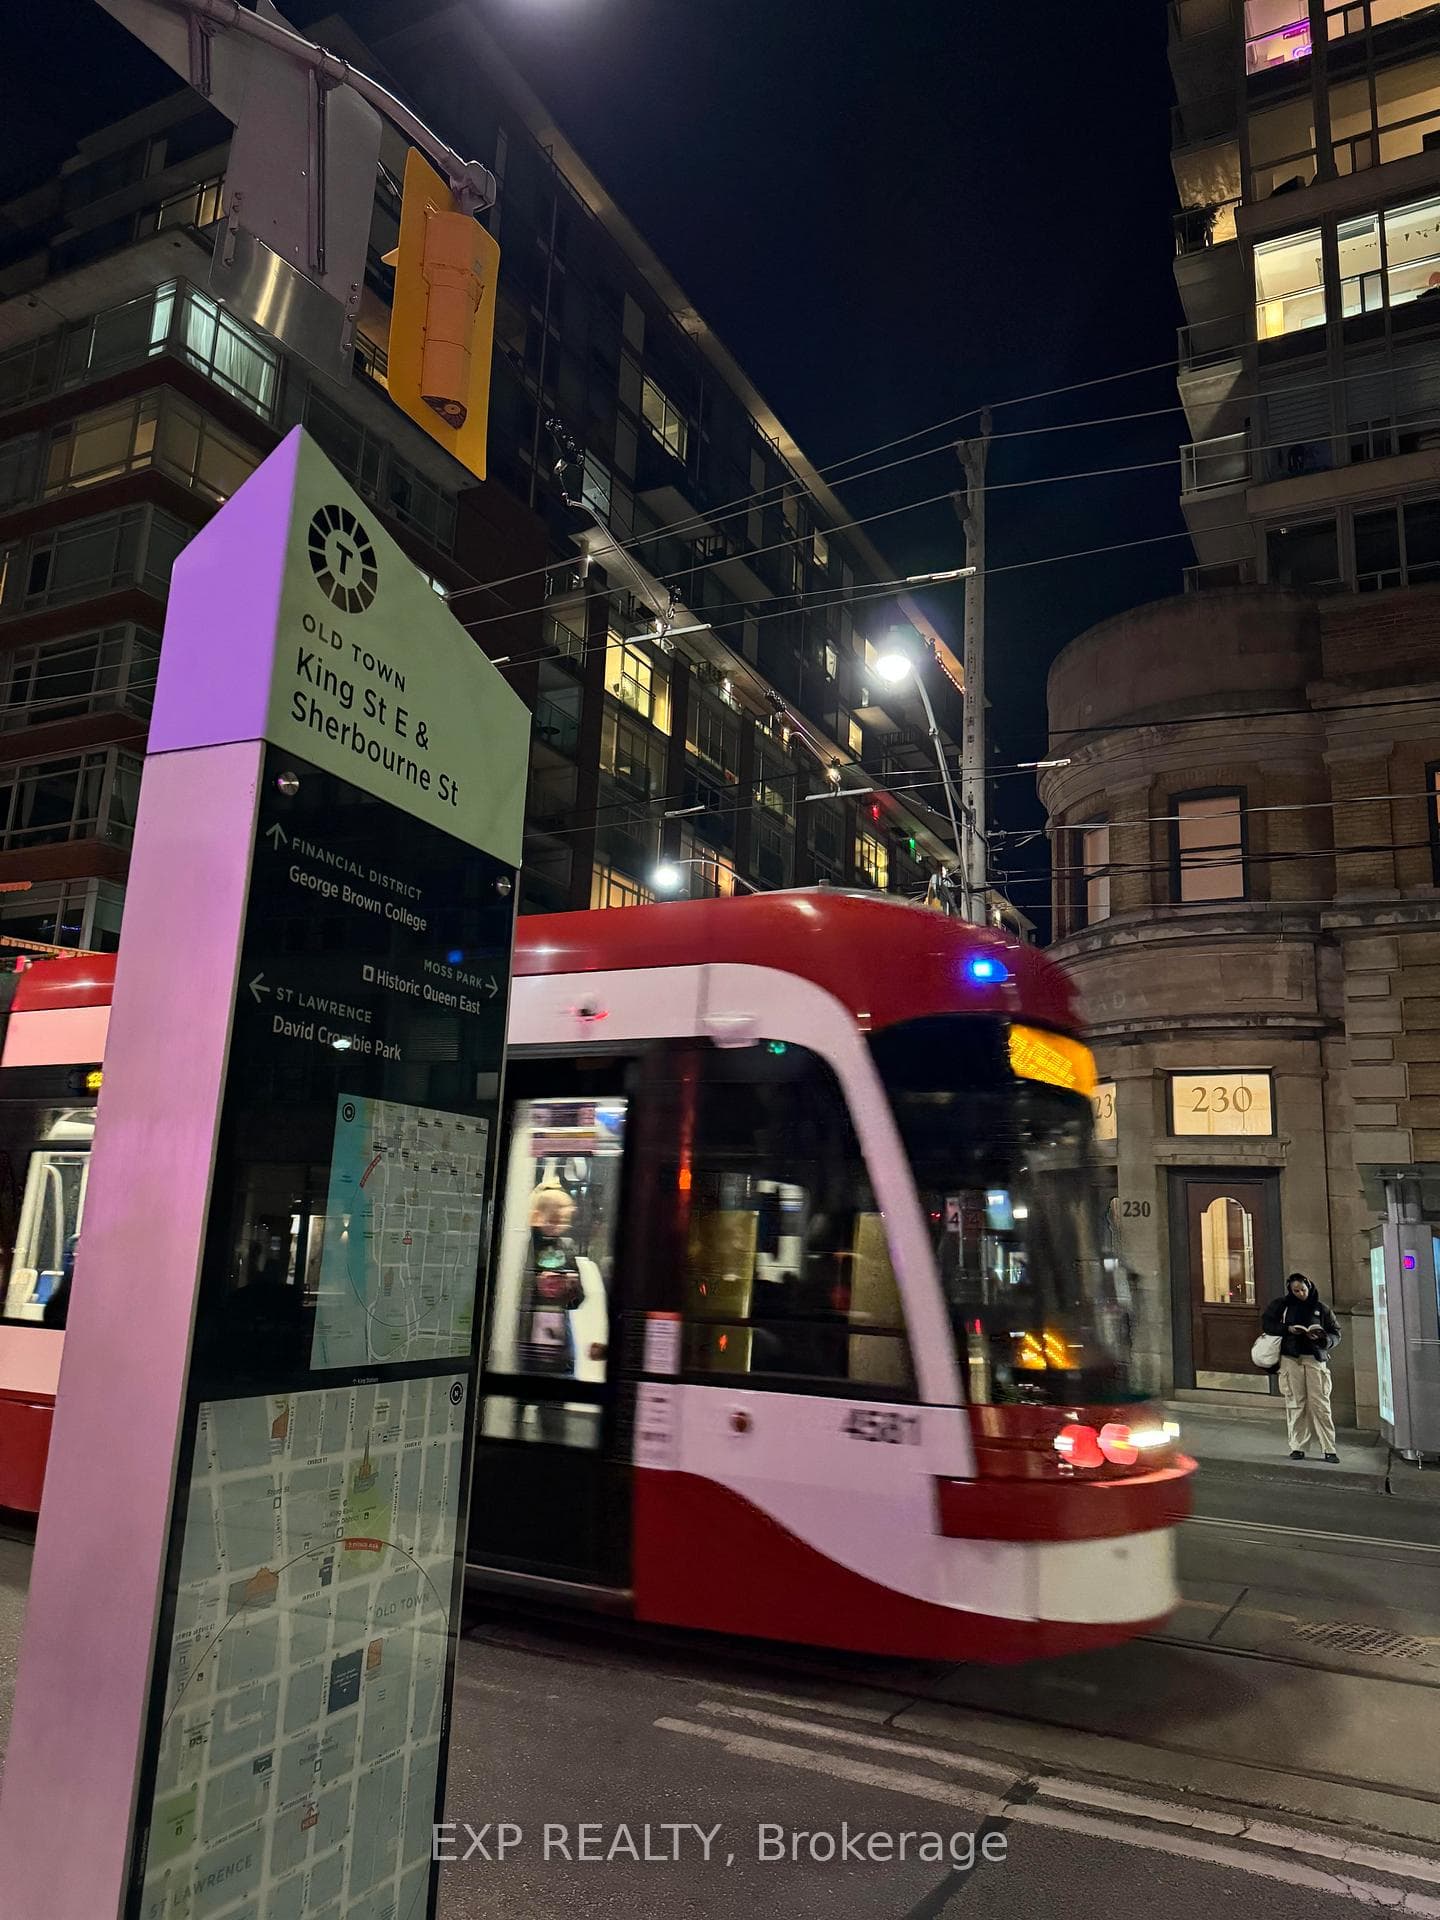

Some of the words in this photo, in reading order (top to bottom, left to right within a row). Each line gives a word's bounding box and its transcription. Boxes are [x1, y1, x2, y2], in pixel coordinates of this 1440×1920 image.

[302, 613, 343, 650] OLD
[351, 643, 406, 693] TOWN
[296, 647, 354, 710] King
[363, 688, 387, 726] St
[395, 706, 408, 738] E
[415, 720, 429, 751] &
[291, 691, 431, 790] Sherbourne
[438, 773, 459, 807] St
[292, 837, 365, 879] FINANCIAL
[369, 869, 423, 901] DISTRICT
[289, 865, 339, 899] George
[342, 885, 382, 915] Brown
[385, 902, 427, 932] College
[376, 968, 420, 998] Historic
[423, 983, 457, 1010] Queen
[459, 994, 481, 1015] East
[424, 959, 453, 980] MOSS
[456, 970, 482, 990] PARK
[276, 987, 294, 1002] ST
[298, 993, 372, 1024] LAWRENCE
[273, 1014, 314, 1042] David
[375, 1038, 401, 1061] Park
[1191, 1086, 1253, 1113] 230
[1122, 1200, 1151, 1218] 230
[376, 1603, 397, 1618] OLD
[400, 1592, 430, 1609] TOWN
[173, 1854, 254, 1907] LAWRENCE
